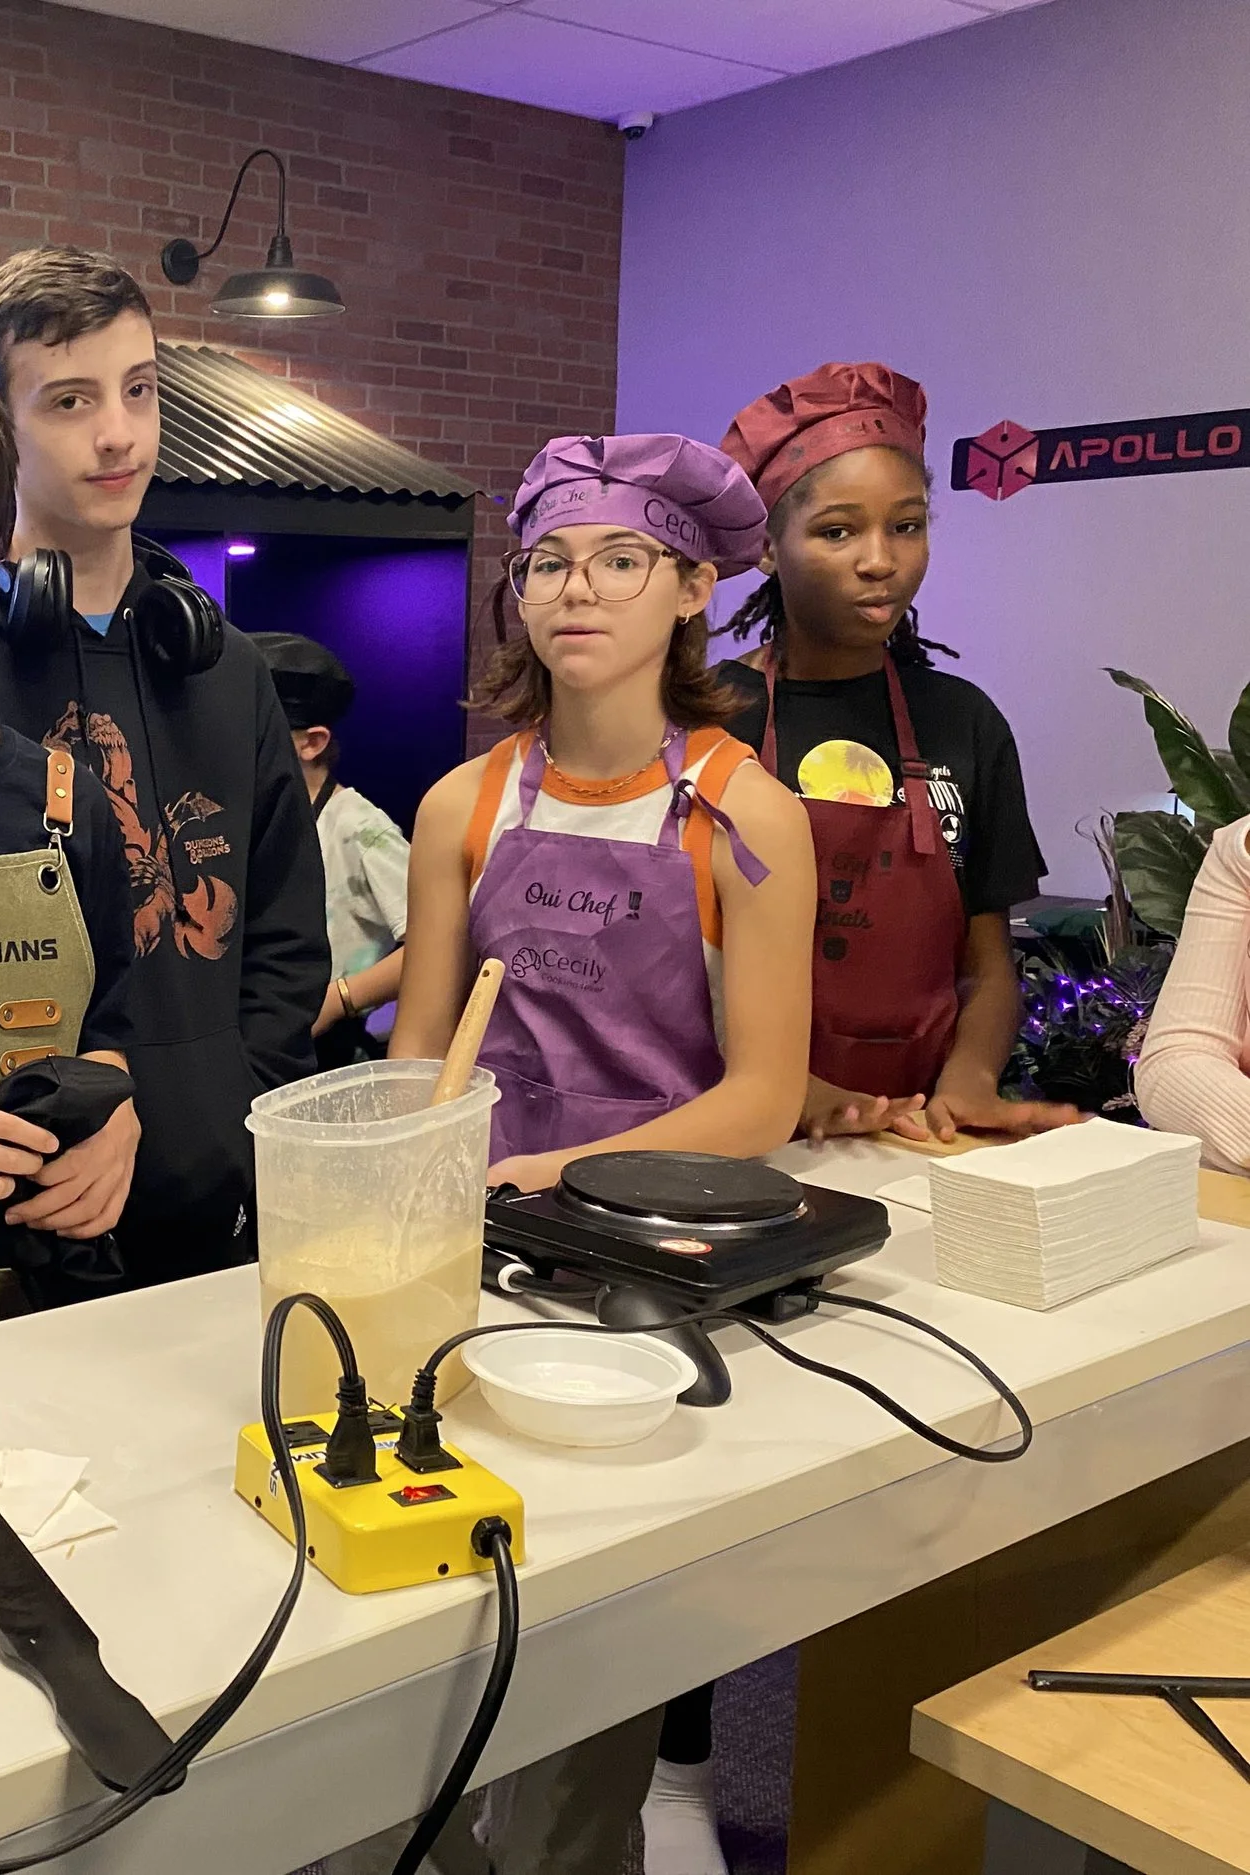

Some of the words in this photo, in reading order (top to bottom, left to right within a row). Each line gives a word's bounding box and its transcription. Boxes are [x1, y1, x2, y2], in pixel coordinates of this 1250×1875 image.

[1049, 425, 1242, 471] APOLLO
[561, 487, 591, 505] Che
[525, 882, 562, 908] Oui
[568, 890, 618, 927] Chef
[543, 949, 607, 983] Cecily
